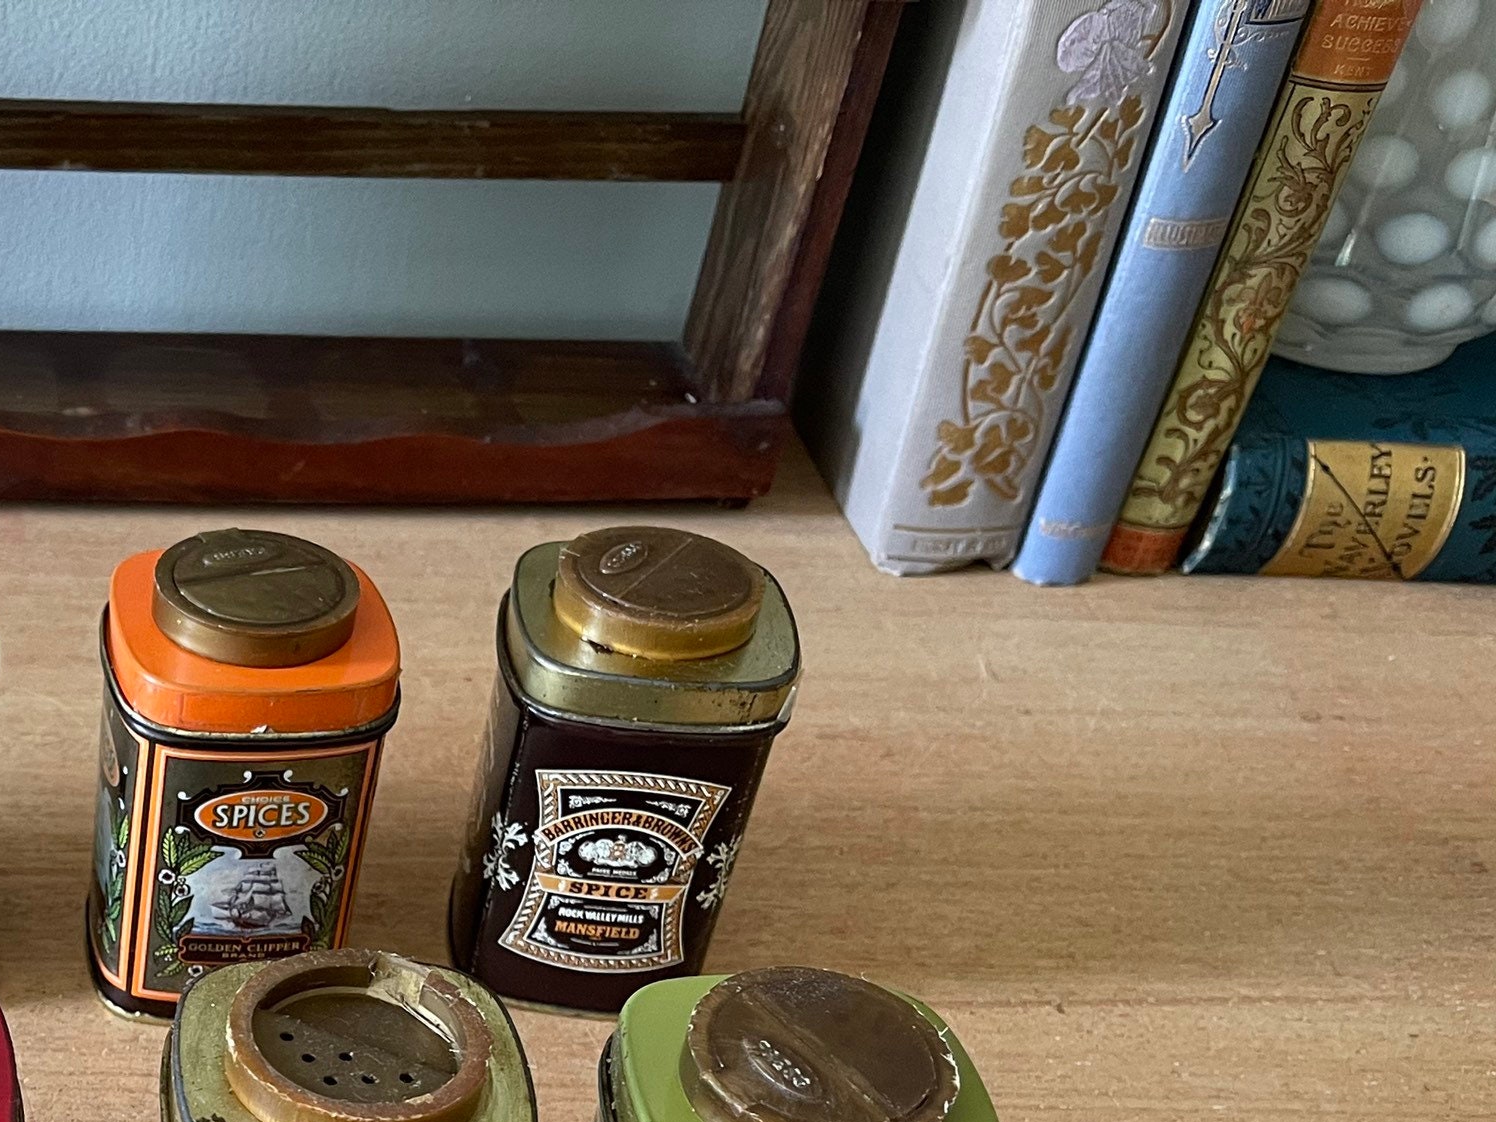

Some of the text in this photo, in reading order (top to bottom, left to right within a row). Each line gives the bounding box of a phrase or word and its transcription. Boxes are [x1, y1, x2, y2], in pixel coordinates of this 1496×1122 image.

[213, 801, 311, 828] SPICES
[568, 882, 649, 900] SPICE
[558, 906, 645, 924] ROCK VALLEY MILLS
[554, 920, 641, 940] MANSFIELD
[188, 941, 300, 952] GOLDEN CLIPPER
